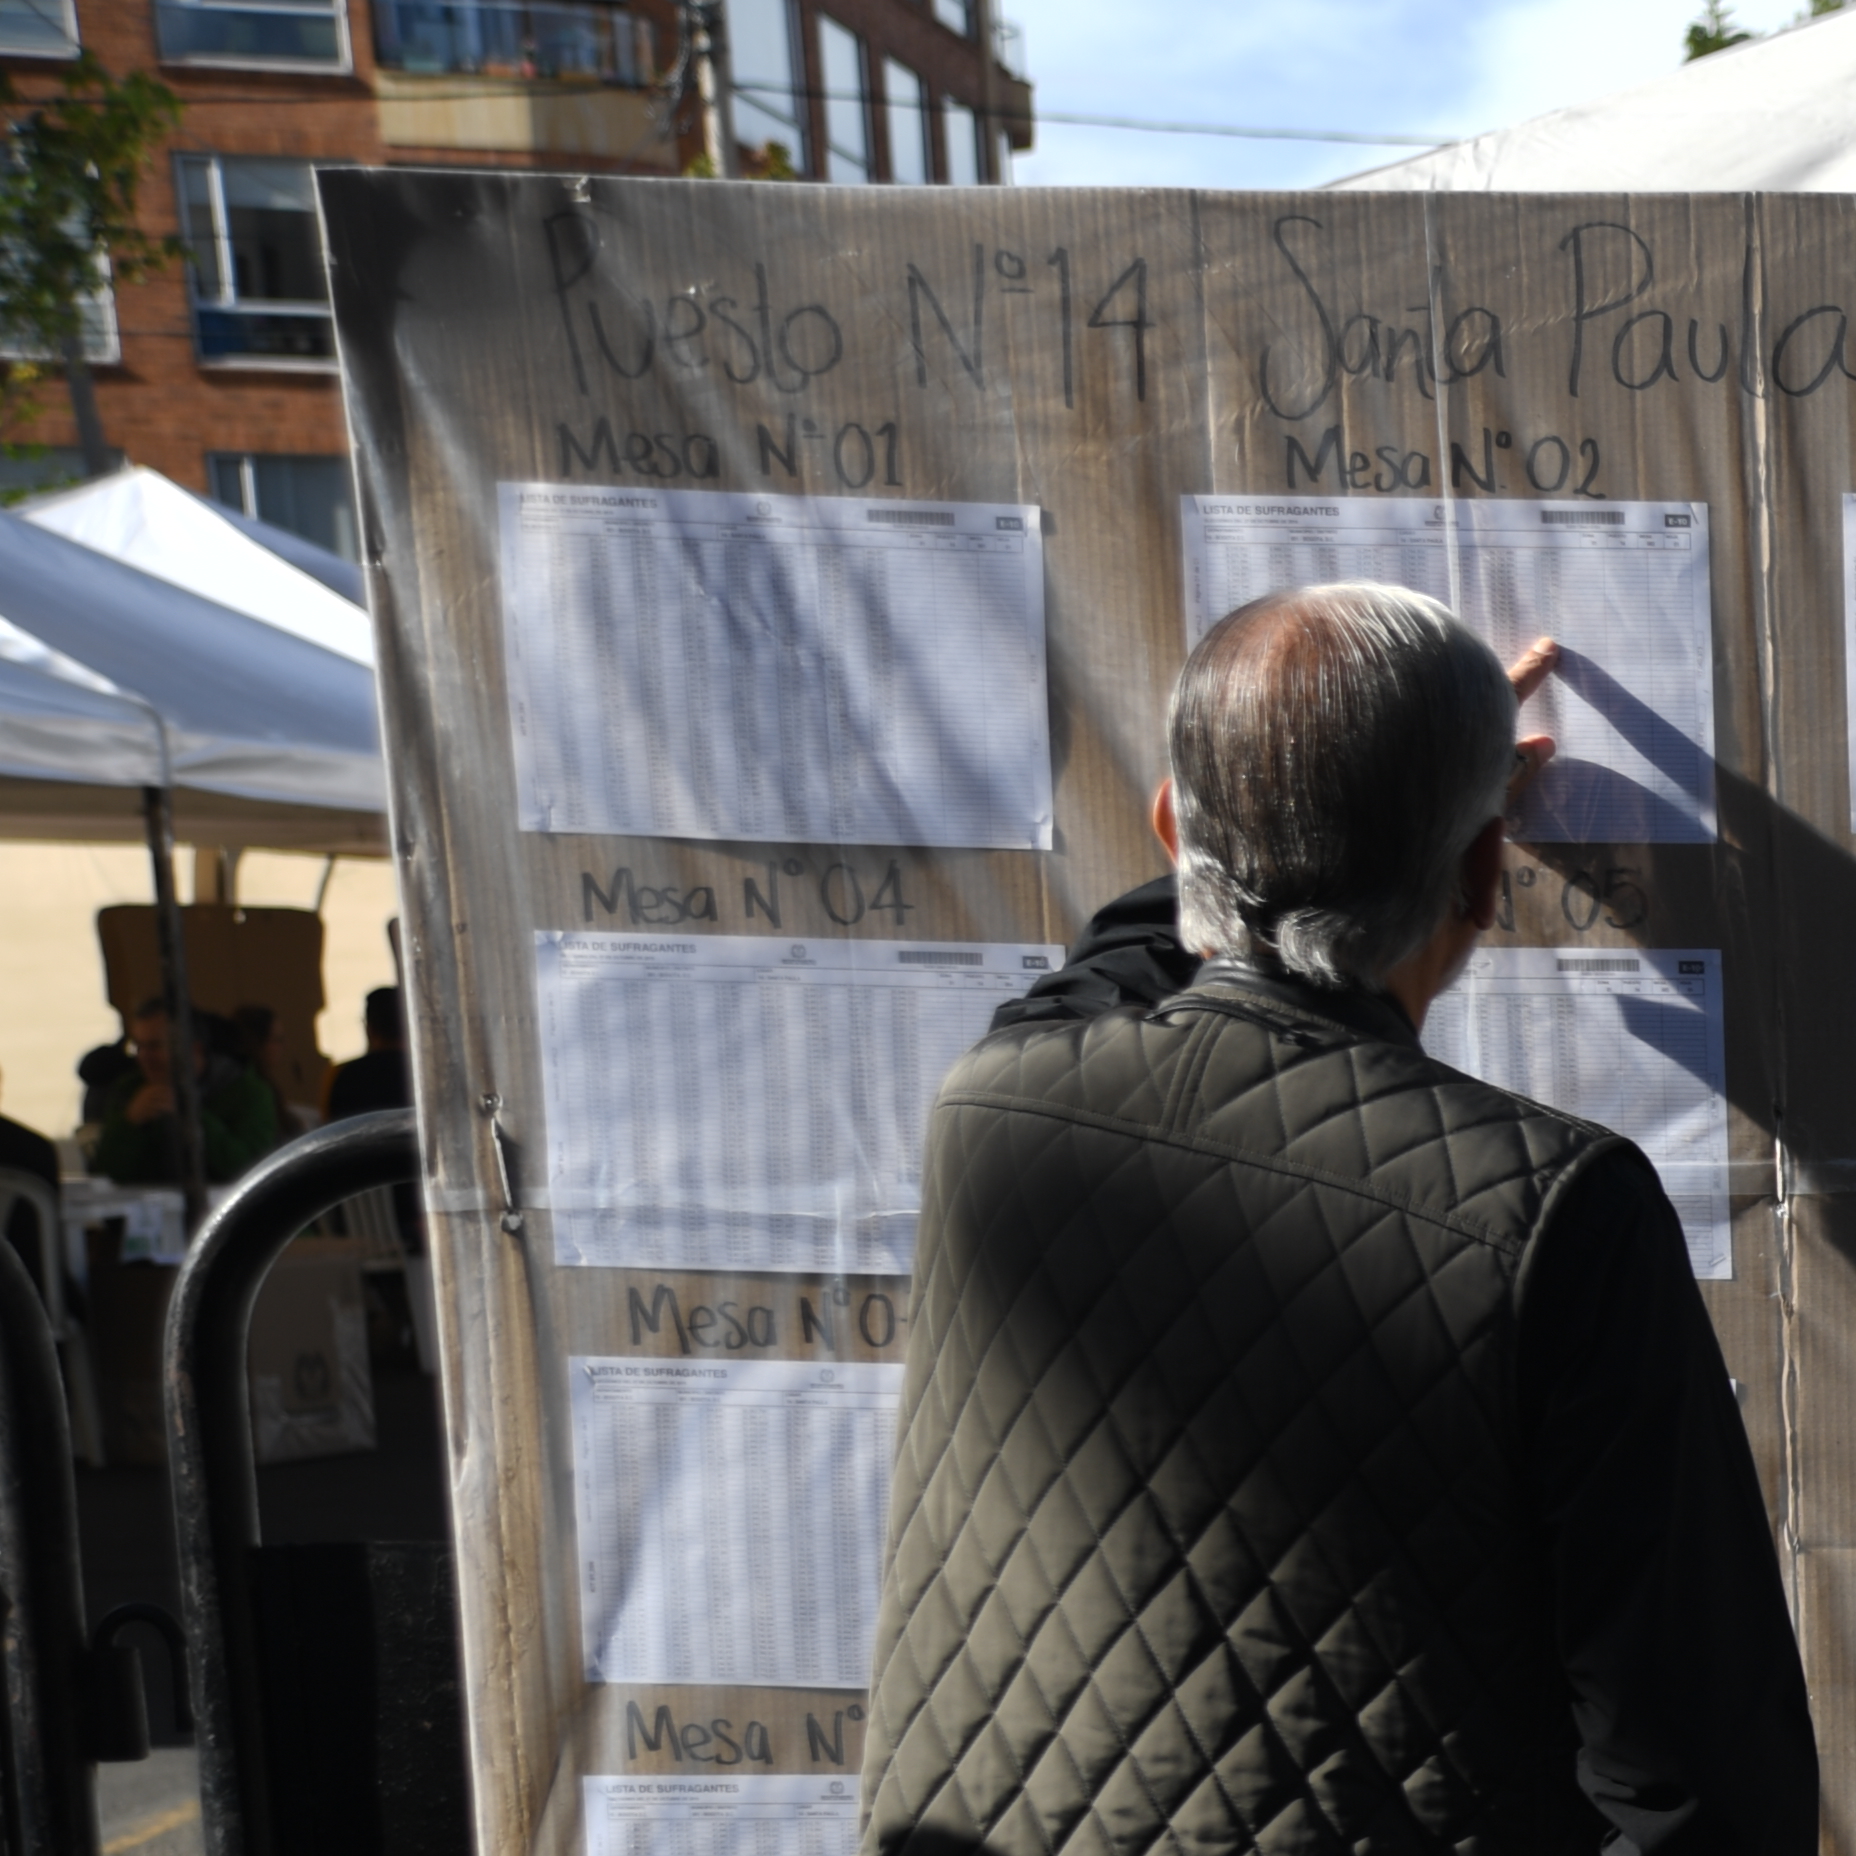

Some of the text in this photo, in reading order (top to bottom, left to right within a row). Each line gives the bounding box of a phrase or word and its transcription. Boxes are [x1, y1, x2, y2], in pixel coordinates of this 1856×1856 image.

[542, 209, 845, 394] Puesto
[1046, 246, 1157, 410] 14
[1259, 214, 1506, 421] Santa
[557, 415, 721, 480] Mesa
[832, 421, 903, 489] 01
[1285, 425, 1433, 493] Mesa
[1526, 435, 1607, 500] 02
[1237, 505, 1252, 516] DE
[1255, 505, 1340, 517] SUFRAGANTES
[581, 866, 718, 926] Mesa
[820, 861, 915, 927] 04
[1560, 867, 1648, 932] 05
[627, 1284, 777, 1355] Mesa
[858, 1292, 908, 1348] 0
[625, 1700, 774, 1766] Mesa
